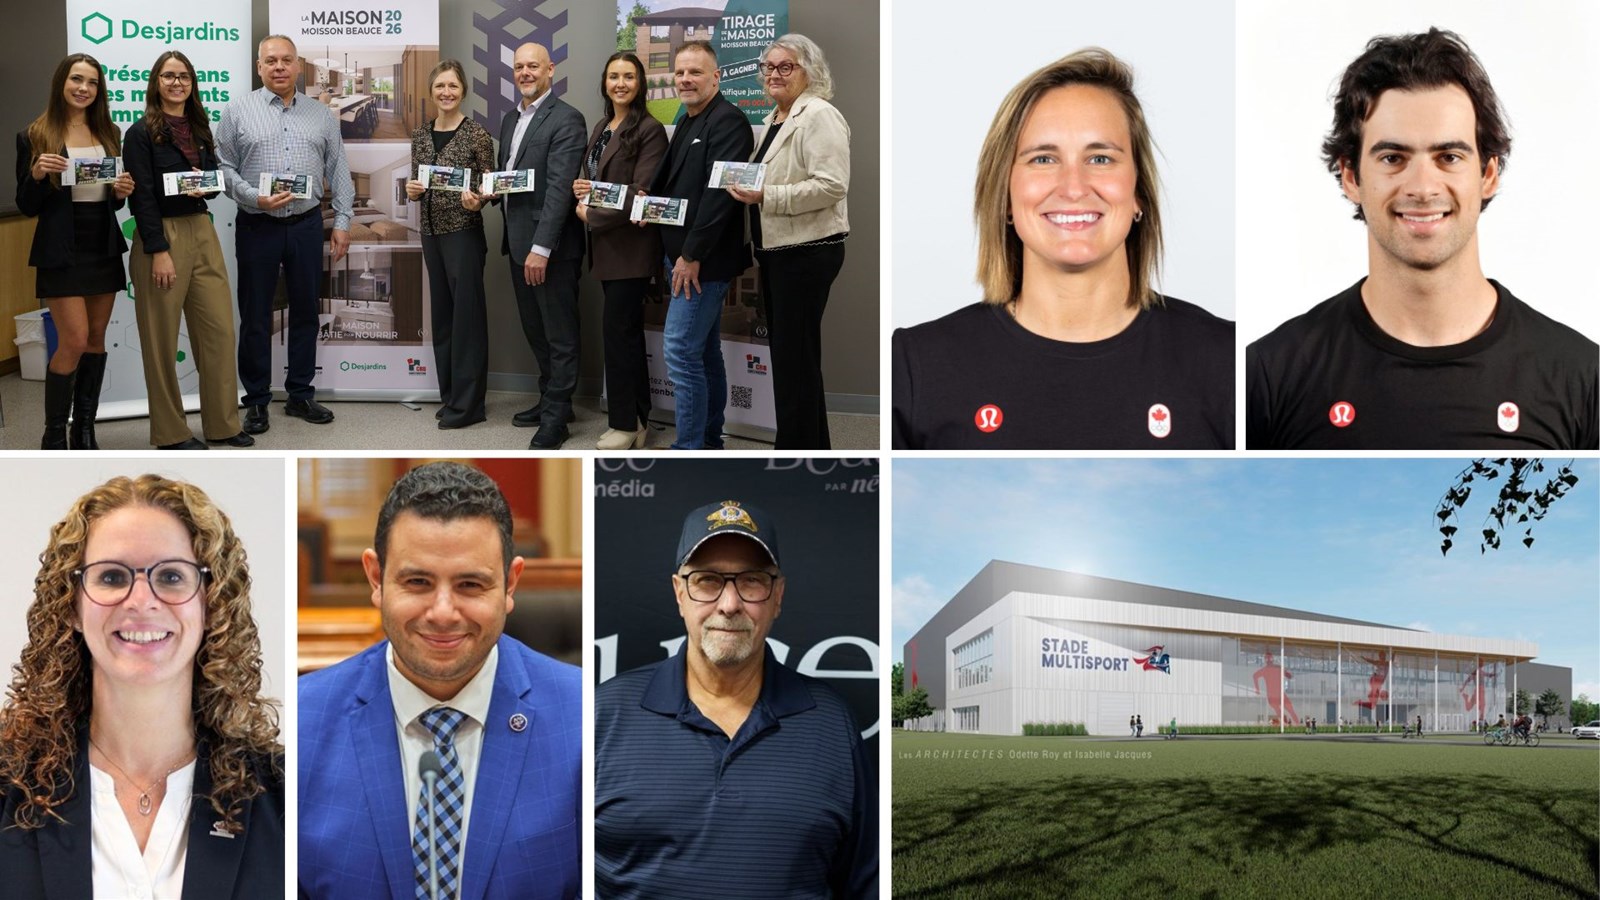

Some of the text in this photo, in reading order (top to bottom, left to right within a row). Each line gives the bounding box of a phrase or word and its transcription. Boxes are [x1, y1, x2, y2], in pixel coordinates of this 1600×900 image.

[311, 11, 382, 25] MAISON
[385, 10, 402, 21] 20
[722, 14, 775, 29] TIRAGE
[122, 20, 240, 44] Desjardins
[302, 27, 343, 35] MOISSON
[385, 23, 402, 34] 26
[728, 28, 775, 40] MAISON
[729, 64, 758, 76] GAGNER
[355, 331, 398, 339] NOURRIR
[351, 362, 386, 371] Desjardins
[825, 483, 847, 491] PAR
[1042, 638, 1088, 654] STADE
[1042, 654, 1129, 672] MULTISPORT
